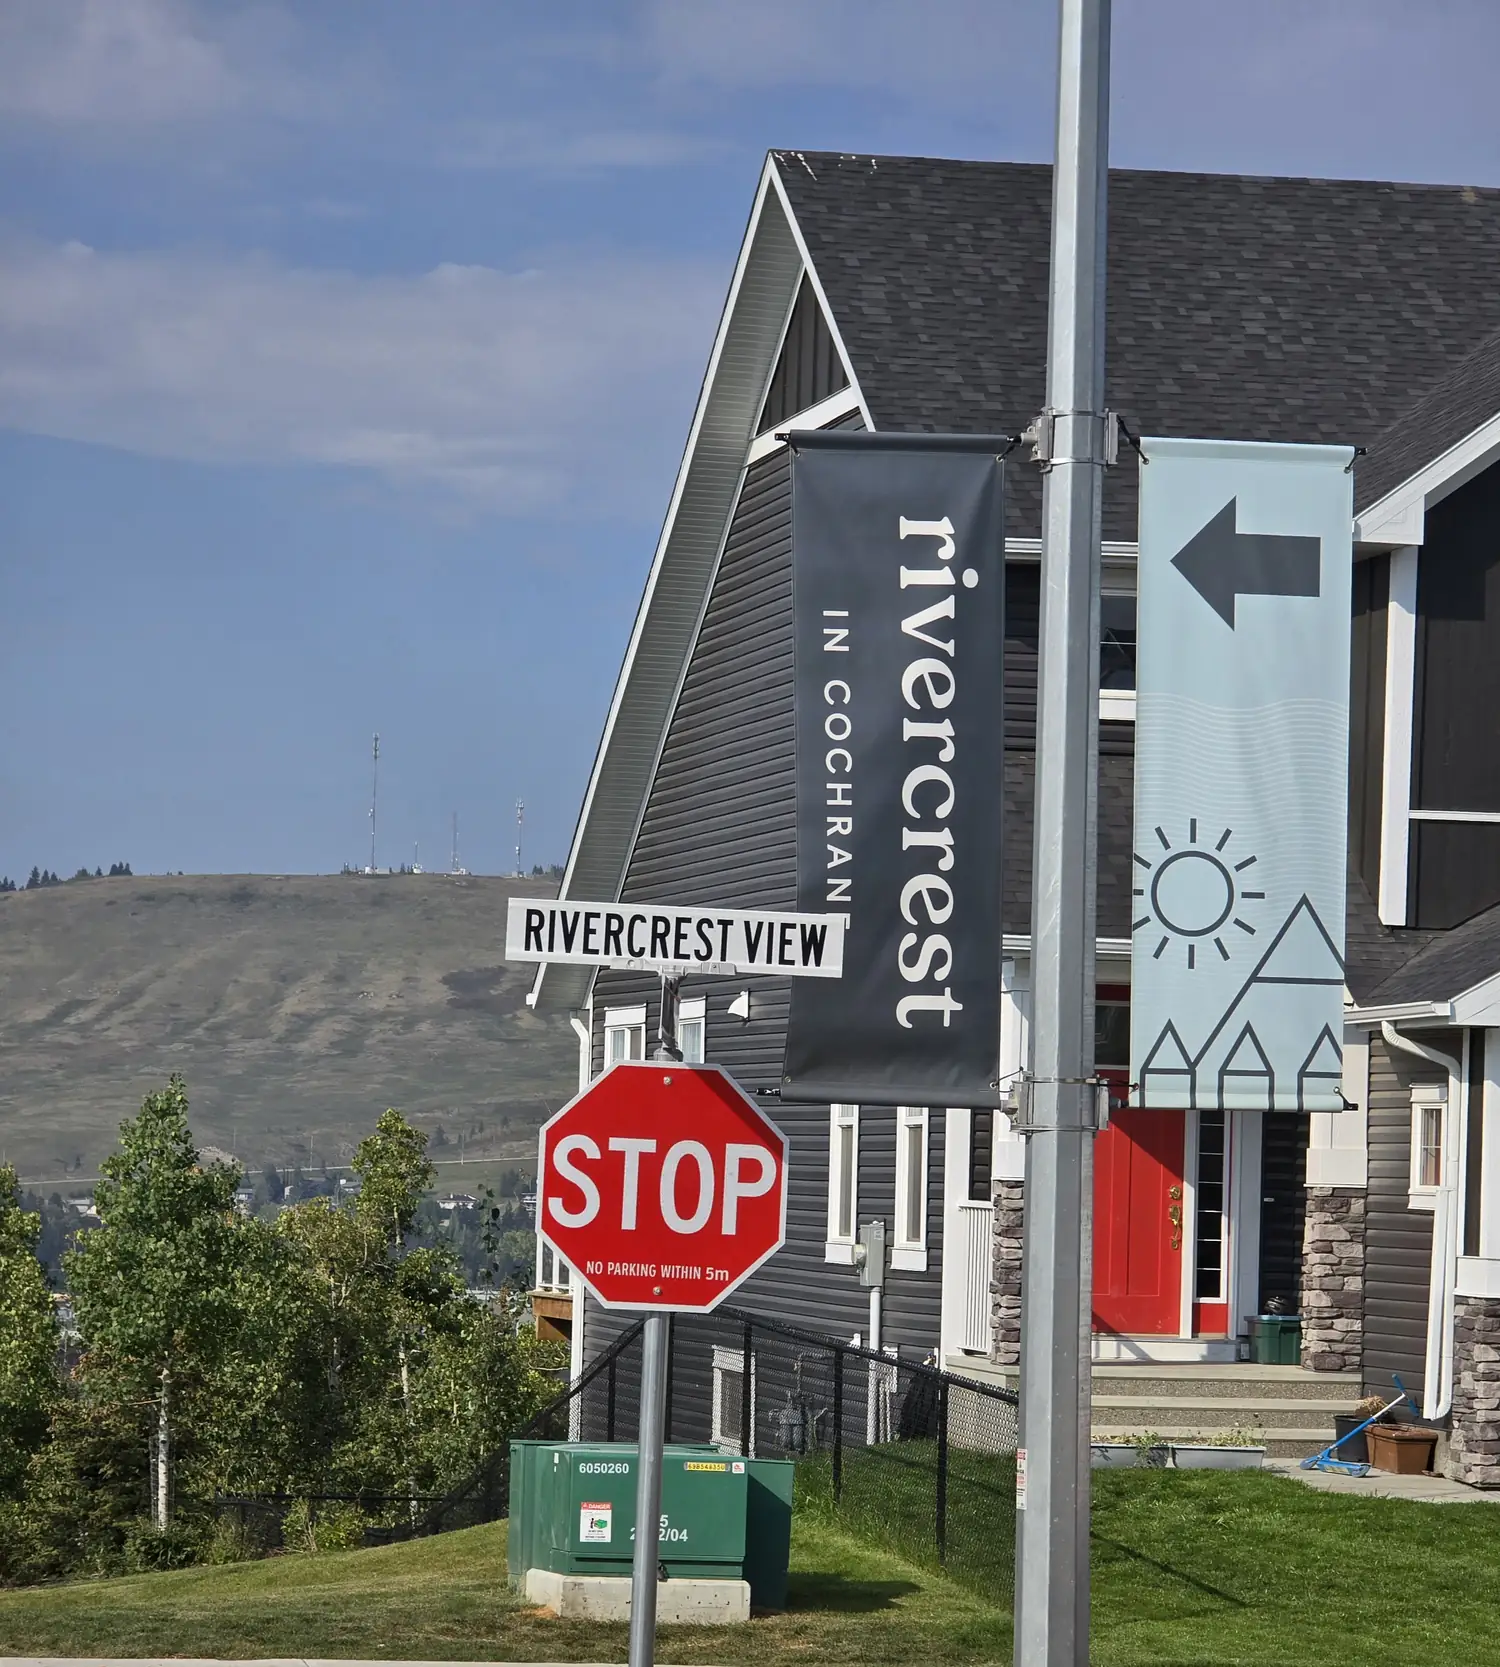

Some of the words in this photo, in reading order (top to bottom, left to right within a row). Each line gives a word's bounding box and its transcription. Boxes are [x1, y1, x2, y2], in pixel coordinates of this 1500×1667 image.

[822, 610, 850, 652] IN
[895, 515, 979, 1029] rivercrest
[524, 908, 734, 963] RIVERCREST
[743, 920, 828, 968] VIEW
[547, 1133, 777, 1236] STOP
[586, 1260, 604, 1275] NO
[608, 1261, 657, 1278] PARKING
[660, 1264, 702, 1280] WITHIN
[705, 1266, 729, 1282] 5m
[578, 1462, 630, 1474] 6050260
